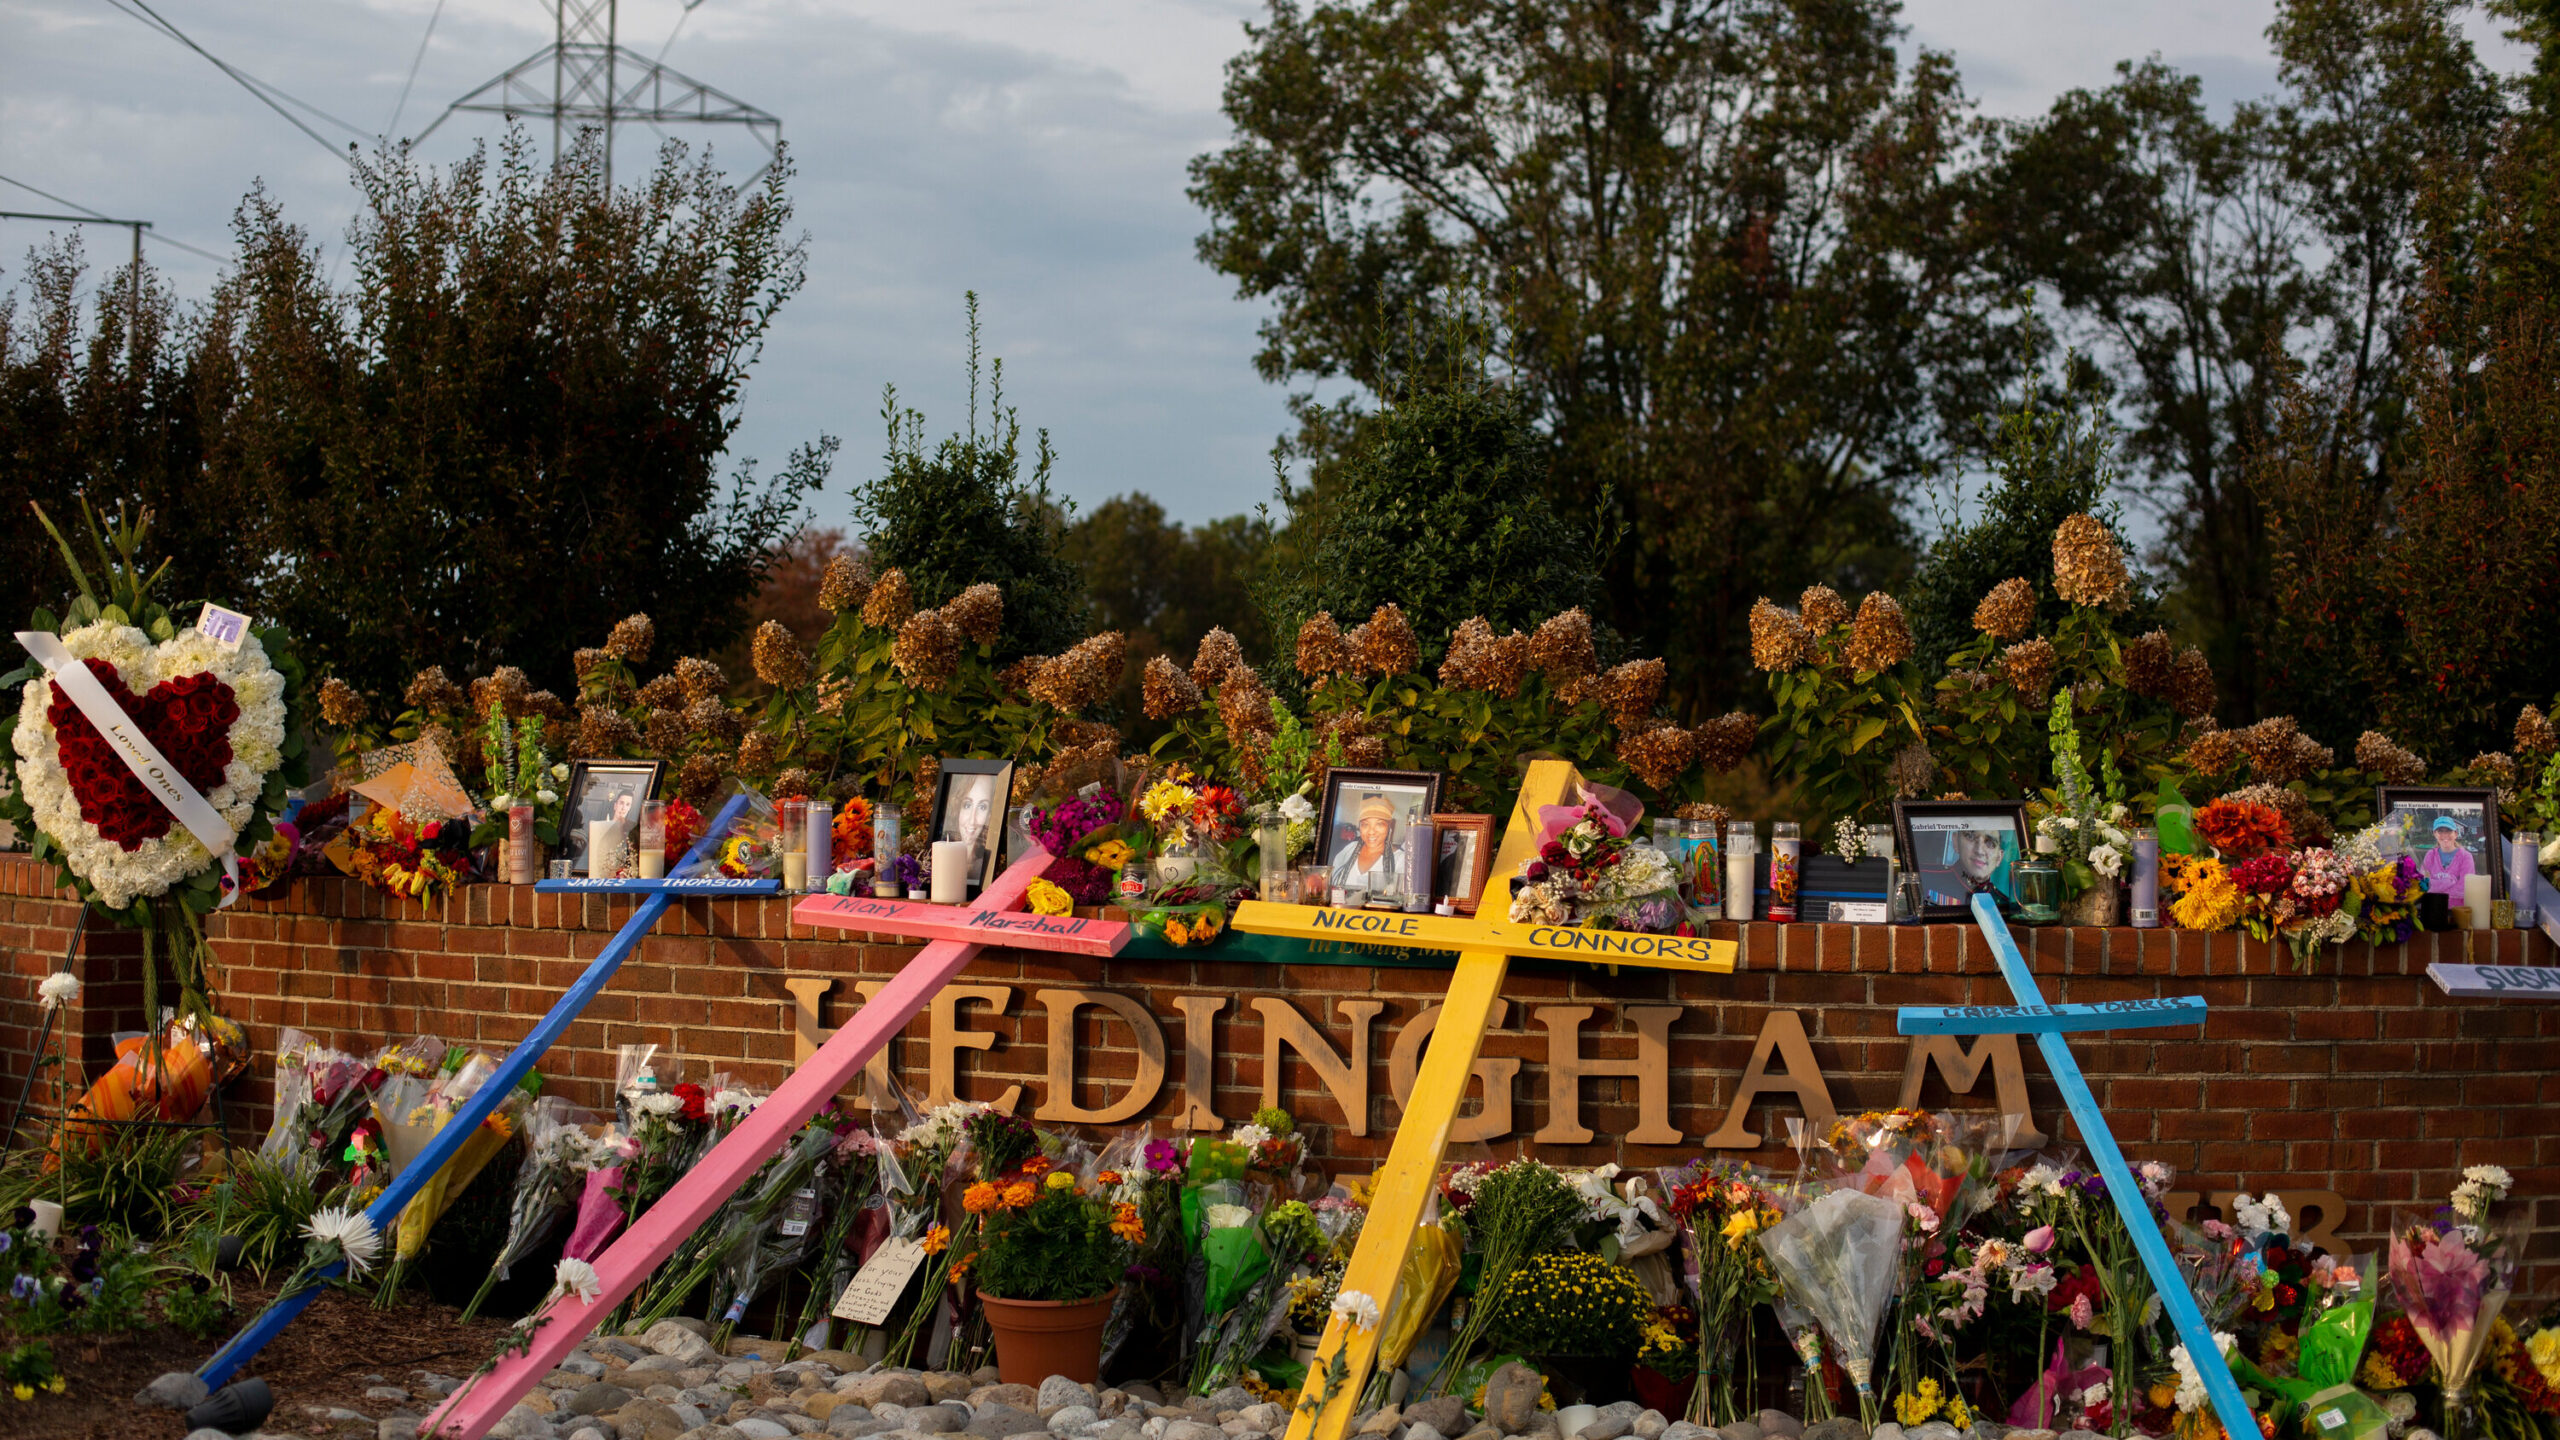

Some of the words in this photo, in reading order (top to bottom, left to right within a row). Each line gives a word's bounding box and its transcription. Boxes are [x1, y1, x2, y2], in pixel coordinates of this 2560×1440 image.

[110, 724, 151, 765] Loved
[149, 767, 184, 801] Ones
[567, 878, 630, 888] JAMES
[661, 878, 759, 888] THOMSON
[832, 898, 907, 918] Mary
[969, 910, 1089, 934] Marshall
[1312, 909, 1419, 936] NICOLE
[1528, 927, 1711, 961] CONNORS
[1943, 1003, 2068, 1019] GABRIEL
[2081, 996, 2192, 1014] TORRES
[785, 977, 2045, 1150] HEDINGHAM
